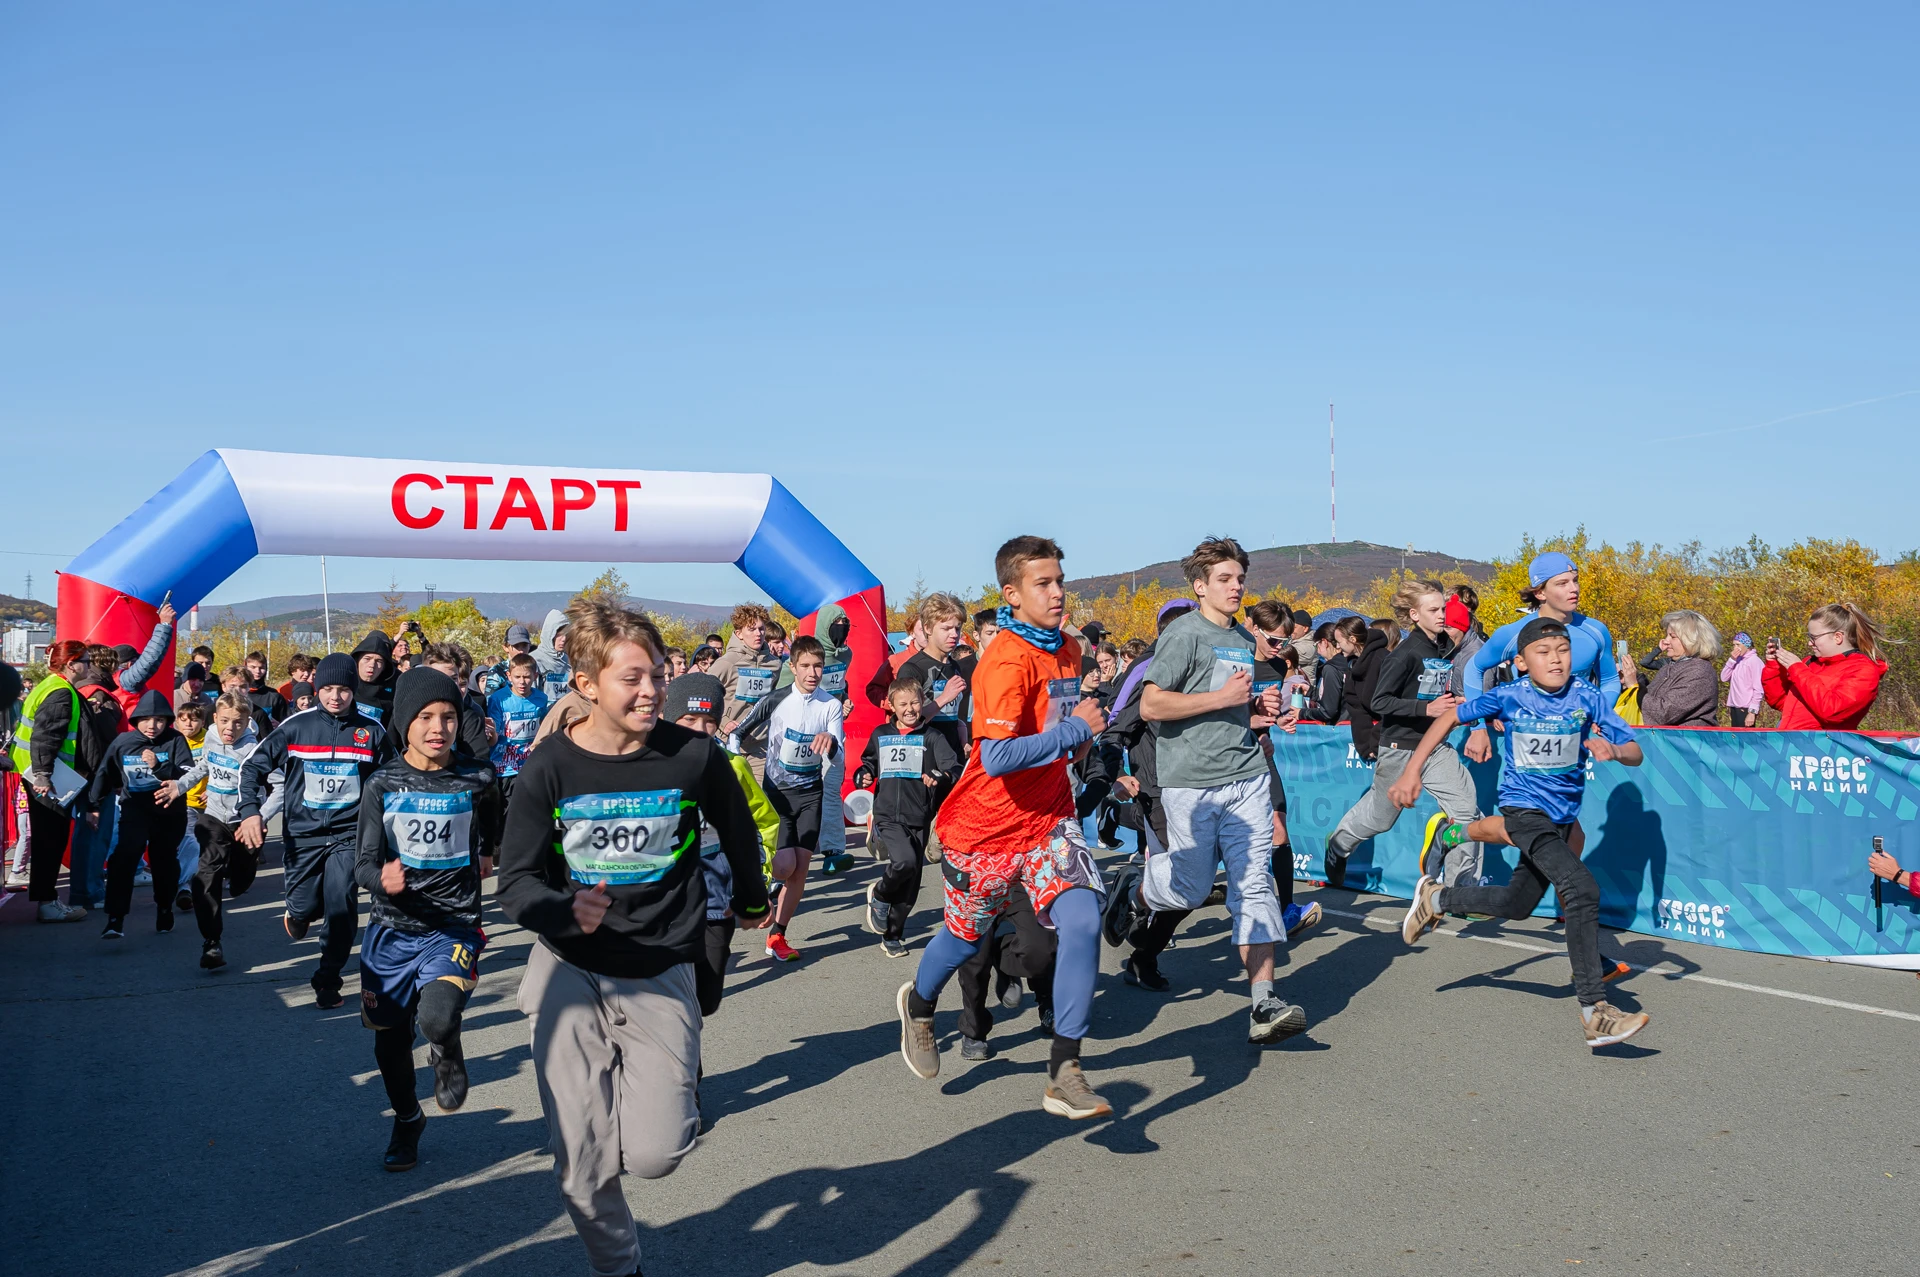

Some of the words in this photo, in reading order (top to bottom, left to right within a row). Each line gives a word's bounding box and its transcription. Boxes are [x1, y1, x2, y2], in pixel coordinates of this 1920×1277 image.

[391, 473, 641, 531] СТАРТ
[748, 679, 764, 691] 156
[830, 674, 839, 684] 42
[555, 683, 568, 695] 344
[521, 720, 537, 733] 110
[1529, 738, 1562, 756] 241
[890, 748, 906, 762] 25
[211, 766, 231, 782] 394
[1789, 756, 1866, 781] КРОСС
[318, 777, 346, 794] 197
[1790, 780, 1867, 794] НАЦИИ
[418, 797, 448, 807] КРОСС
[602, 797, 641, 809] КРОСС
[406, 819, 452, 844] 284
[591, 825, 650, 852] 360
[629, 863, 657, 871] ОБЛАСТЬ
[1657, 899, 1725, 927] КРОСС
[1660, 919, 1725, 939] НАЦИИ
